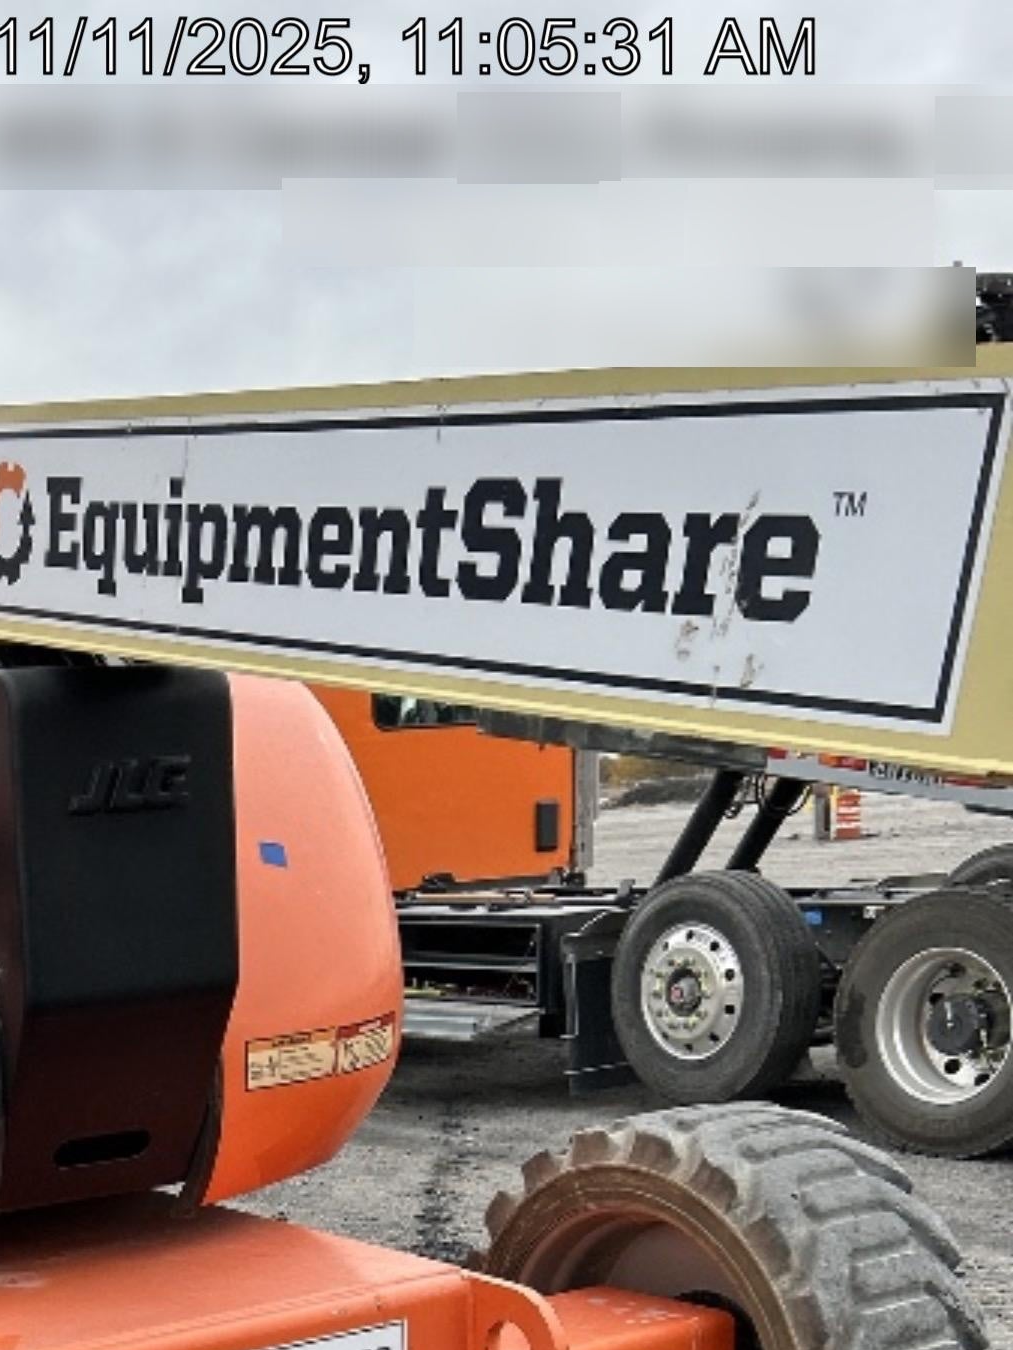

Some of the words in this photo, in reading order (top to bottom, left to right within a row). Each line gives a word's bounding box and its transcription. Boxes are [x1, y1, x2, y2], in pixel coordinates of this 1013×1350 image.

[44, 475, 821, 622] EquipmentShare
[832, 491, 867, 517] TM
[67, 755, 191, 816] JLG
